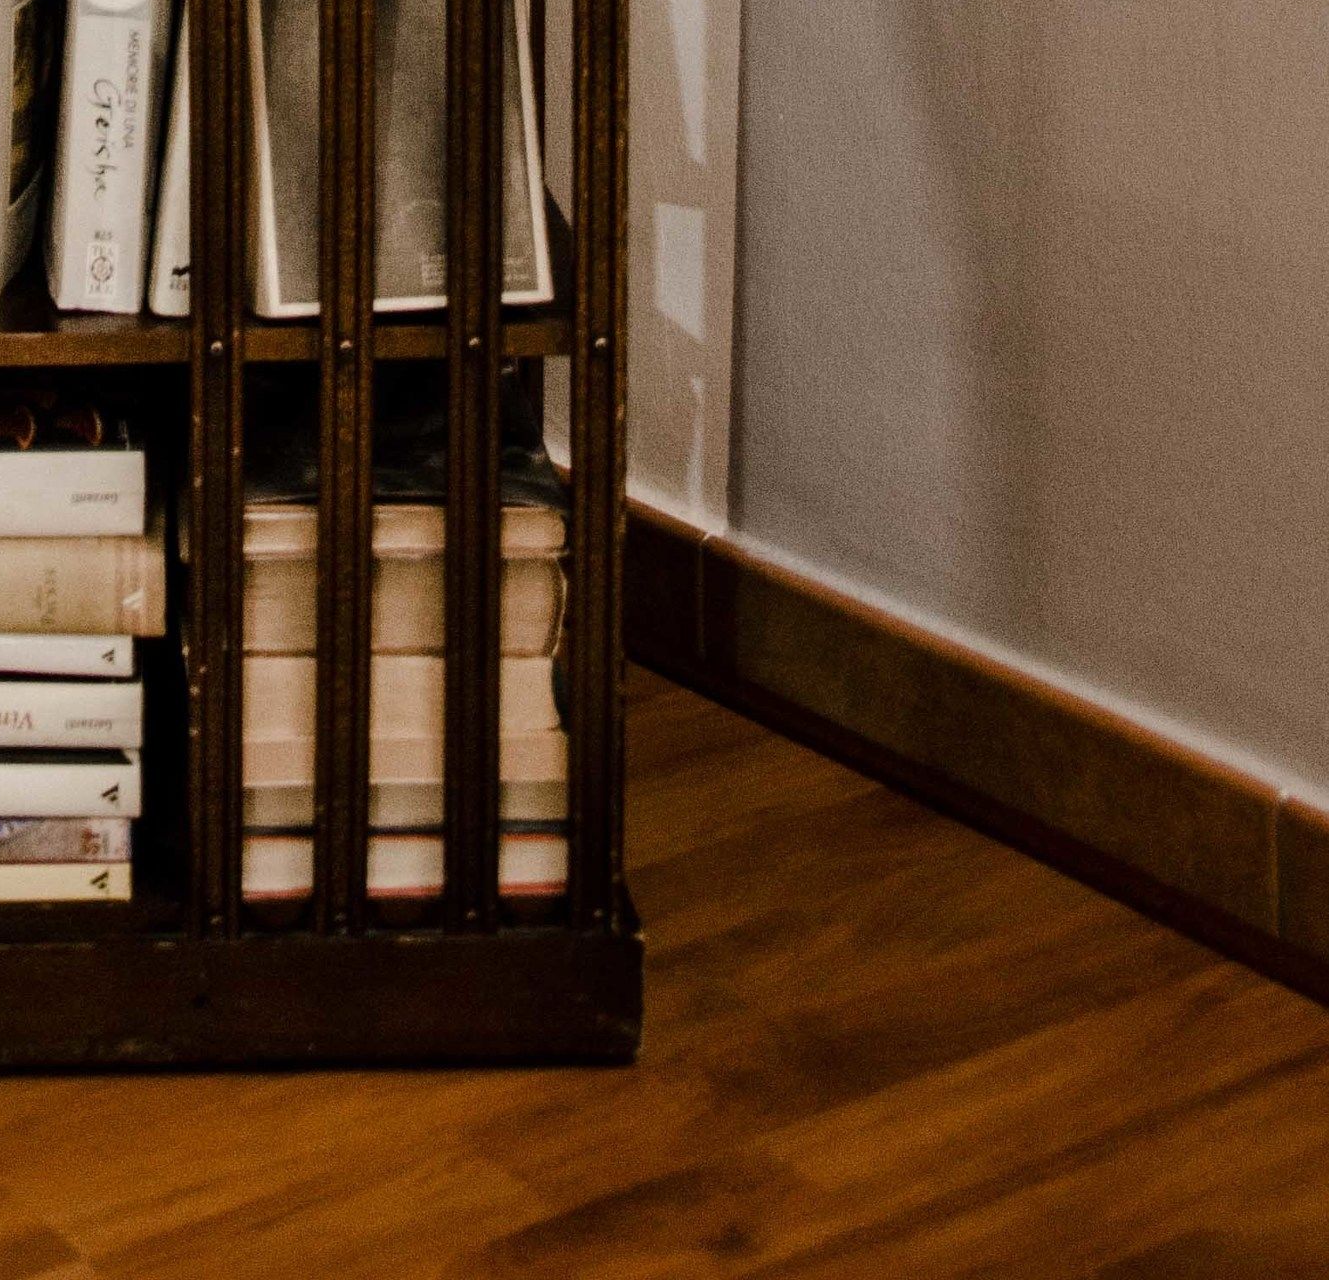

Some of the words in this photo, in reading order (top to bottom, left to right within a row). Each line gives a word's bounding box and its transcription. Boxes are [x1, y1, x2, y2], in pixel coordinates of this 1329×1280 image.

[124, 30, 143, 94] MEMORIE
[124, 99, 136, 114] DI
[79, 78, 125, 199] Geisha
[121, 117, 135, 148] UNA
